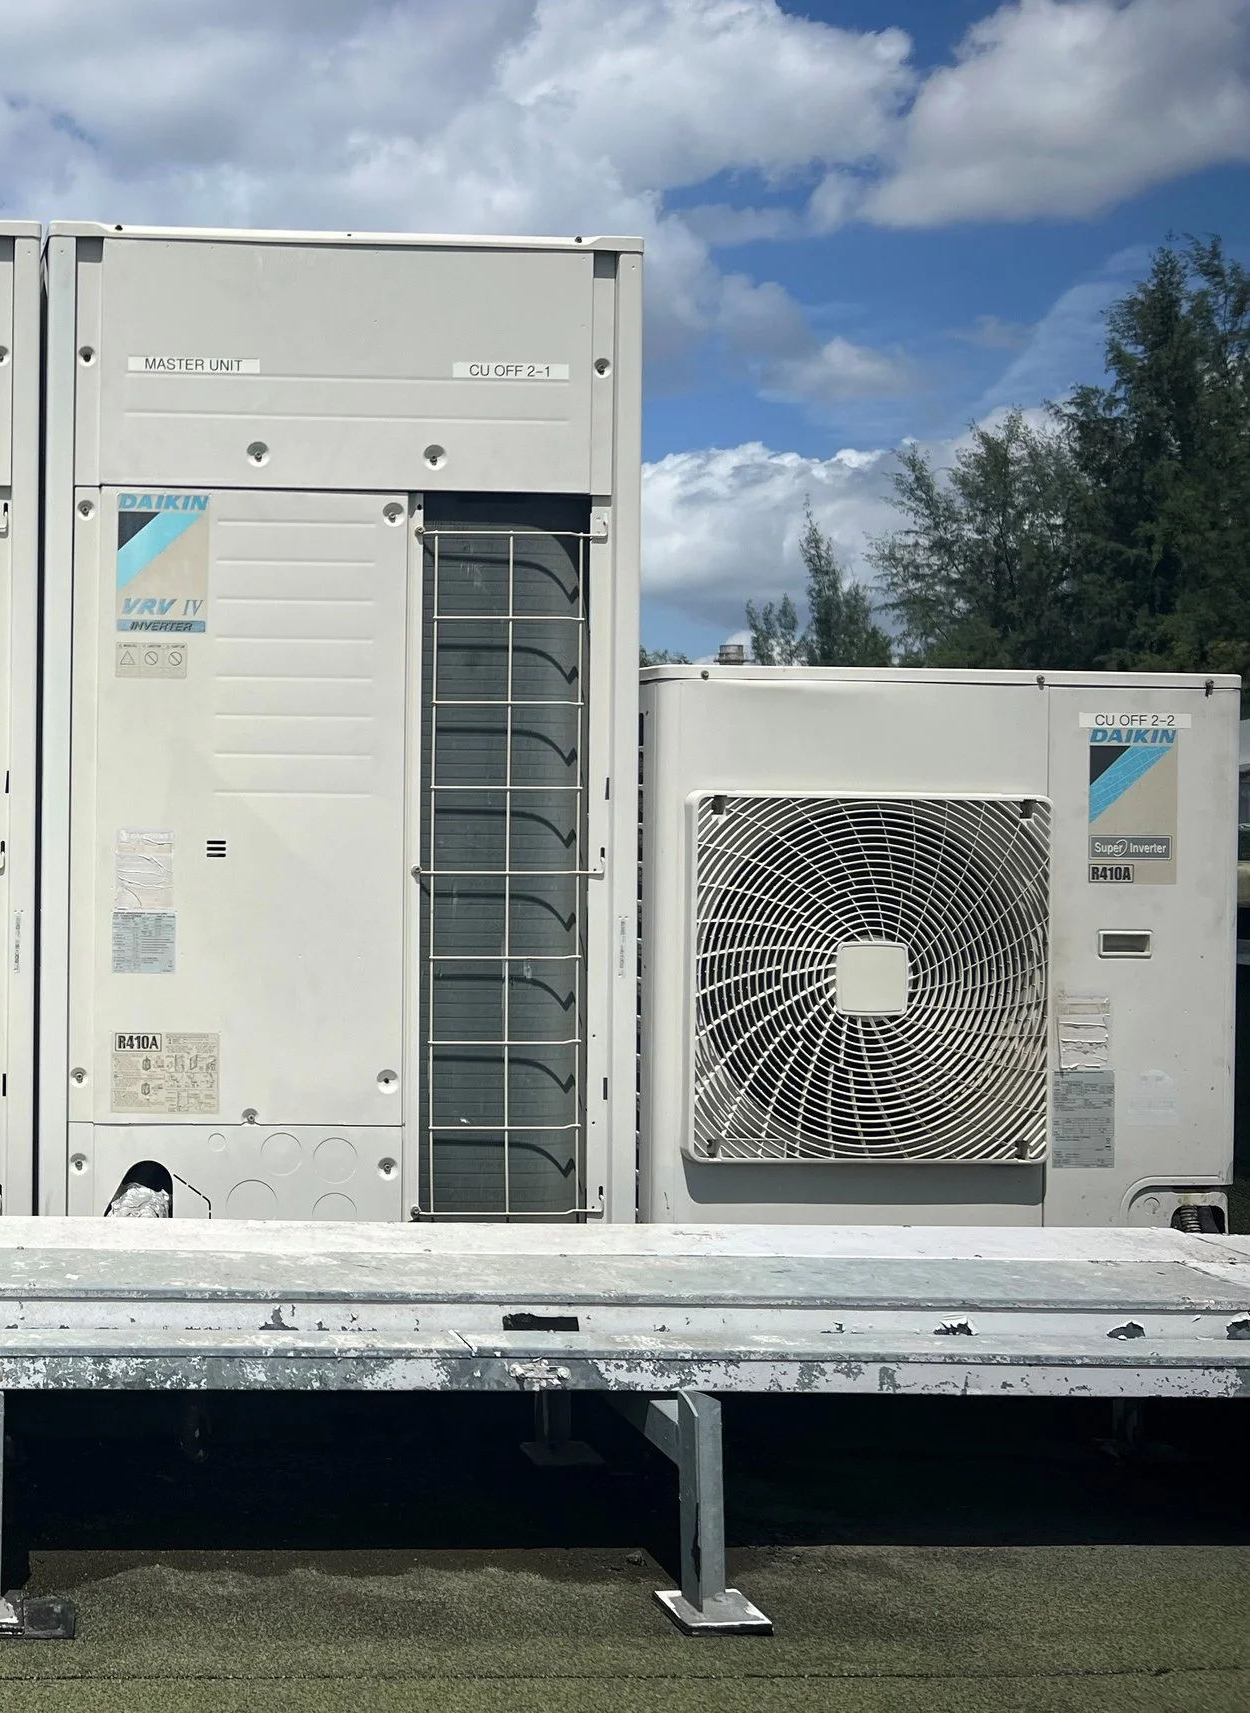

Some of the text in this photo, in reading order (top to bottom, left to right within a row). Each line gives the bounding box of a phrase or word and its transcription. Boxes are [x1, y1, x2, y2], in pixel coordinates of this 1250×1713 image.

[144, 357, 243, 372] MASTER UNIT
[469, 363, 550, 378] CU OFF 2-1
[118, 493, 209, 511] DAIKIN
[122, 598, 205, 617] VRV IV
[130, 621, 194, 632] INVERTER
[1094, 714, 1175, 727] CU OFF 2-2
[1090, 728, 1177, 744] DAIKIN
[1094, 841, 1167, 855] Super Inverter
[1091, 866, 1132, 881] R410A
[117, 1035, 159, 1050] R410A
